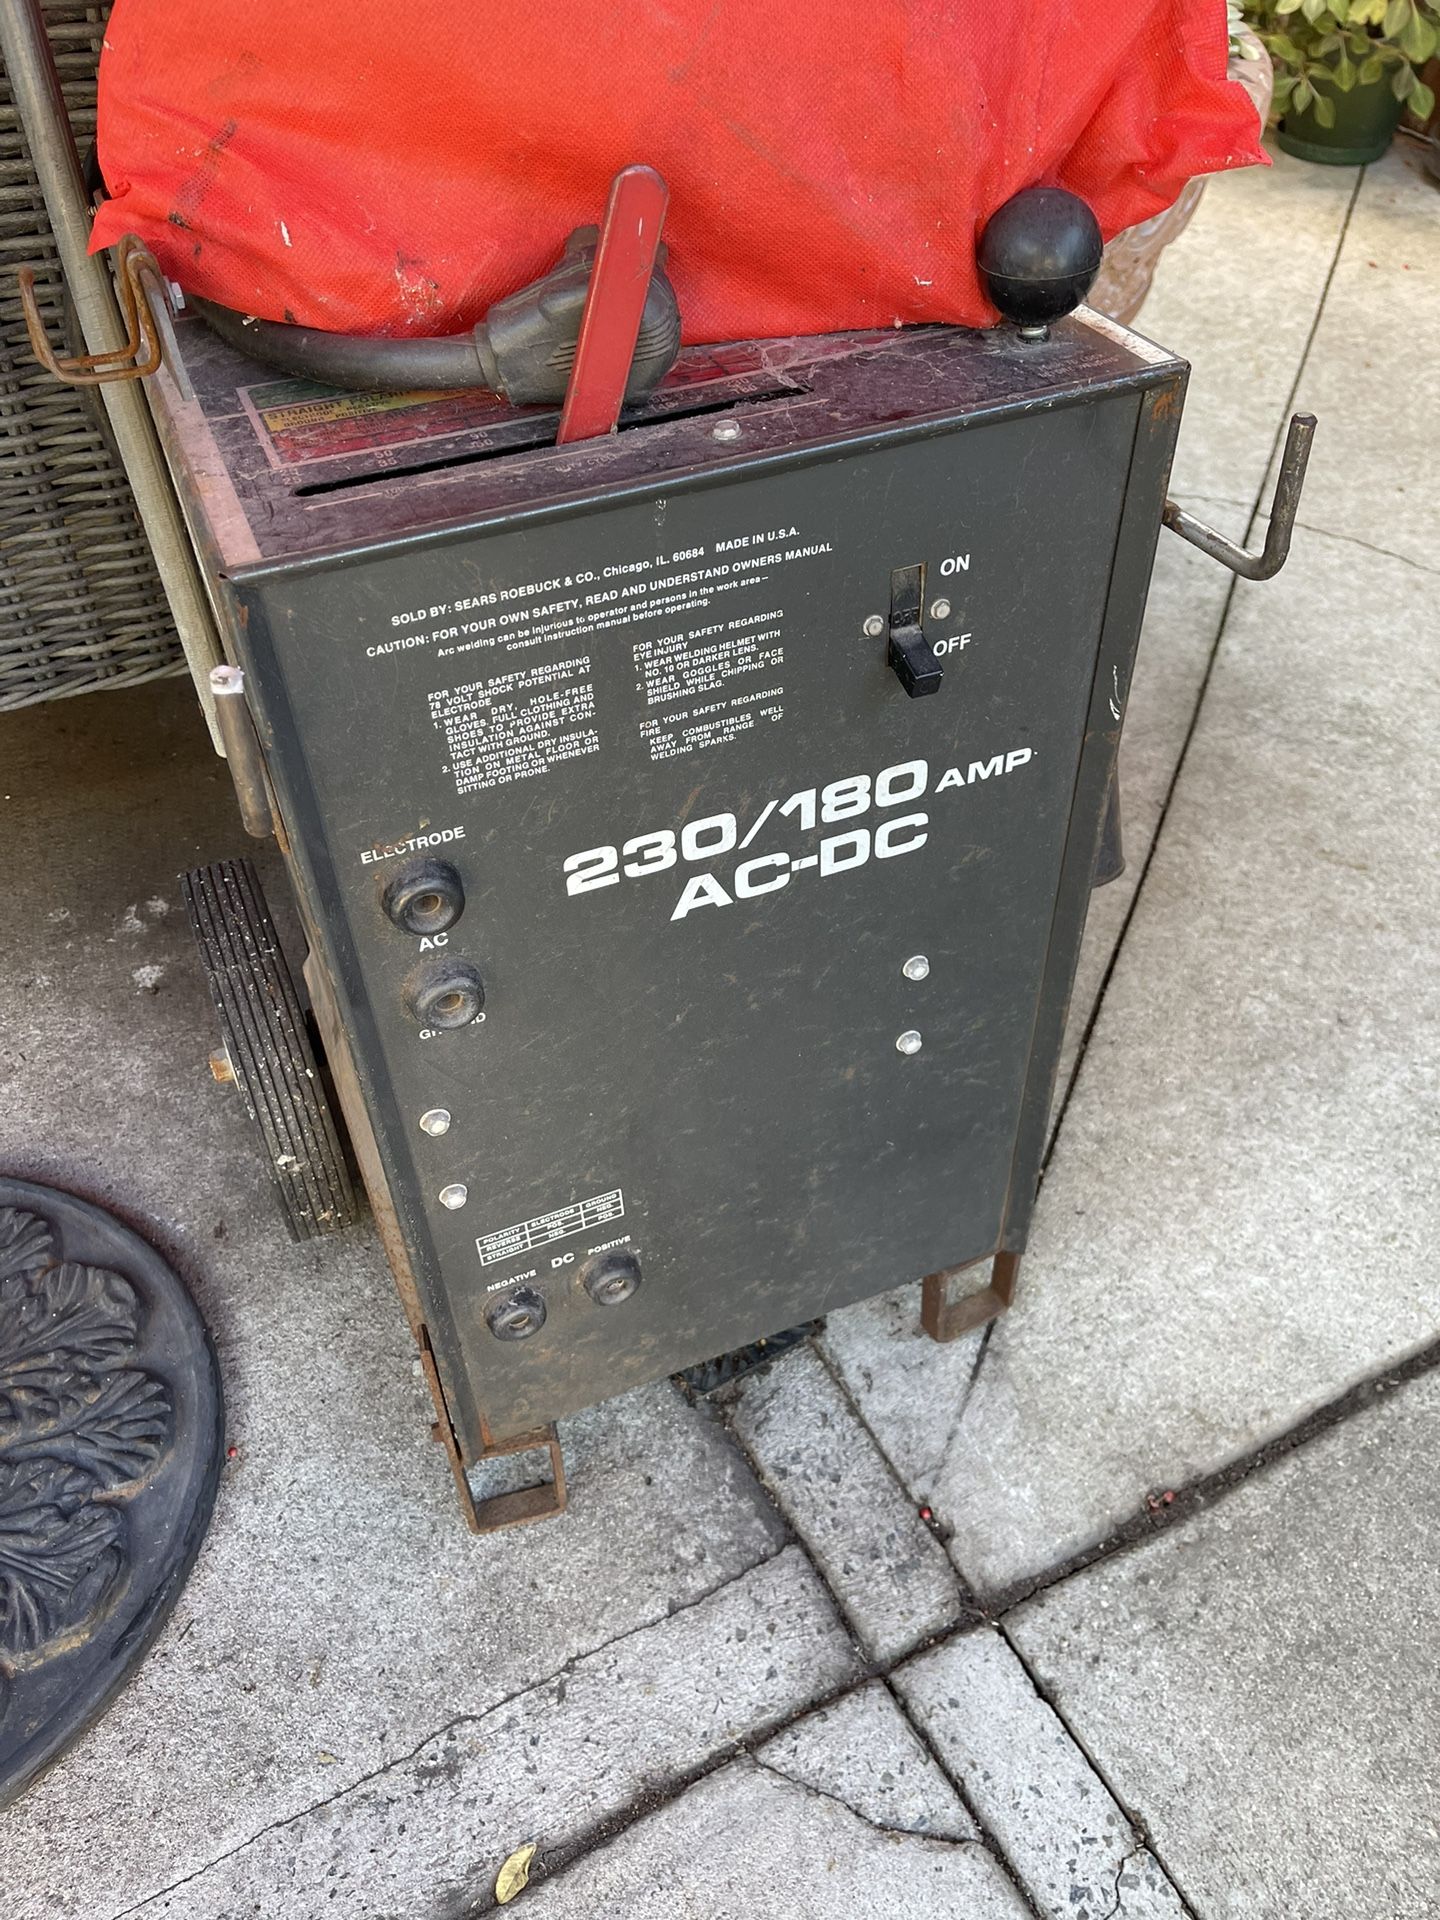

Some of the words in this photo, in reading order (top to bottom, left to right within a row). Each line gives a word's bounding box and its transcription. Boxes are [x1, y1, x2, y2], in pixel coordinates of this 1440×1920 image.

[391, 609, 427, 626] SOLD
[429, 604, 452, 617] BY:
[454, 593, 497, 611] SEARS
[500, 578, 561, 601] ROEBUCK
[564, 576, 573, 586] &
[575, 571, 600, 584] CO.,
[602, 560, 652, 577] Chicago,
[656, 555, 670, 566] IL.
[672, 546, 704, 562] 60684
[715, 536, 749, 552] MADE
[752, 533, 764, 544] IN
[767, 526, 800, 541] U.S.A.
[940, 554, 970, 576] ON
[366, 634, 429, 657] CAUTION:
[431, 626, 458, 642] FOR
[460, 618, 496, 634] YOUR
[499, 610, 529, 625] OWN
[532, 598, 582, 618] SAFETY,
[585, 589, 618, 606] READ
[621, 583, 646, 598] AND
[649, 564, 729, 591] UNDERSTAND
[732, 553, 782, 572] OWNERS
[785, 542, 832, 560] MANUAL
[437, 647, 455, 657] Arc
[456, 637, 495, 652] welding
[497, 632, 515, 643] can
[517, 629, 530, 638] be
[575, 616, 585, 626] to
[587, 606, 629, 622] operator
[630, 600, 647, 614] and
[649, 592, 687, 609] persons
[688, 590, 697, 601] in
[699, 586, 714, 595] the
[716, 580, 738, 591] work
[506, 635, 542, 651] consult
[541, 624, 594, 642] instruction
[596, 614, 630, 629] manual
[632, 608, 662, 621] before
[664, 598, 710, 614] operating.
[632, 641, 652, 652] FOR
[656, 633, 684, 646] YOUR
[688, 623, 724, 639] SAFETY
[728, 609, 783, 629] REGARDING
[633, 650, 652, 661] EYE
[653, 641, 688, 656] INJURY
[643, 656, 672, 669] WEAR
[673, 645, 717, 663] WELDING
[718, 635, 756, 653] HELMET
[757, 629, 780, 641] WITH
[644, 668, 662, 678] NO.
[664, 664, 674, 673] 10
[676, 660, 690, 670] OR
[692, 650, 730, 666] DARKER
[732, 644, 759, 656] LENS.
[933, 633, 971, 657] OFF
[427, 689, 449, 701] FOR
[453, 681, 483, 695] YOUR
[487, 670, 528, 687] SAFETY
[530, 656, 591, 679] REGARDING
[428, 701, 441, 710] 78
[446, 692, 473, 706] VOLT
[477, 683, 513, 698] SHOCK
[518, 669, 574, 688] POTENTIAL
[578, 664, 591, 674] AT
[635, 683, 644, 691] 2.
[645, 674, 676, 689] WEAR
[682, 660, 730, 679] GOGGLES
[737, 655, 753, 667] OR
[758, 647, 783, 662] FACE
[646, 681, 680, 696] SHIELD
[685, 672, 715, 688] WHILE
[721, 660, 764, 678] CHIPPING
[770, 656, 783, 665] OR
[431, 697, 492, 719] ELECTRODE
[433, 721, 442, 729] 1.
[443, 712, 478, 728] WEAR
[529, 683, 593, 707] HOLE-FREE
[492, 712, 517, 724] FULL
[520, 698, 570, 718] CLOTHING
[573, 692, 594, 706] AND
[639, 719, 658, 730] FOR
[662, 711, 688, 724] YOUR
[692, 701, 726, 716] SAFETY
[730, 686, 783, 706] REGARDING
[647, 686, 695, 705] BRUSHING
[697, 679, 724, 692] SLAG.
[447, 728, 484, 744] SHOES
[488, 723, 503, 732] TO
[509, 710, 556, 728] PROVIDE
[561, 701, 595, 718] EXTRA
[449, 729, 514, 752] INSULATION
[519, 716, 564, 736] AGAINST
[569, 710, 596, 722] CON-
[640, 726, 660, 738] FIRE
[649, 733, 673, 746] KEEP
[682, 712, 753, 737] COMBUSTIBLES
[759, 705, 784, 717] WELL
[650, 740, 677, 753] AWAY
[685, 731, 711, 745] FROM
[723, 719, 754, 736] RANGE
[771, 712, 783, 722] OF
[441, 765, 450, 773] 2.
[452, 758, 473, 770] USE
[475, 744, 535, 764] ADDITIONAL
[537, 737, 556, 749] DRY
[559, 728, 597, 746] INSULA-
[450, 747, 475, 759] TACT
[478, 740, 503, 752] WITH
[505, 730, 550, 746] GROUND.
[453, 765, 480, 778] TION
[484, 760, 500, 770] ON
[505, 751, 541, 767] METAL
[545, 740, 580, 757] FLOOR
[584, 735, 599, 748] OR
[455, 772, 484, 786] DAMP
[485, 761, 530, 780] FOOTING
[530, 757, 546, 769] OR
[546, 743, 600, 763] WHENEVER
[650, 744, 693, 760] WELDING
[698, 733, 736, 748] SPARKS.
[457, 778, 496, 794] SITTING
[498, 774, 512, 784] OR
[514, 765, 550, 780] PRONE.
[361, 826, 466, 864] ELECTRODE
[563, 760, 928, 897] 230/180
[670, 813, 928, 921] AC-DC
[419, 932, 449, 952] AC
[483, 1228, 520, 1244] POLARITY
[487, 1244, 524, 1260] STRAIGHT
[588, 1236, 631, 1255] POSITIVE
[551, 1253, 575, 1268] DC
[487, 1270, 537, 1292] NEGATIVE
